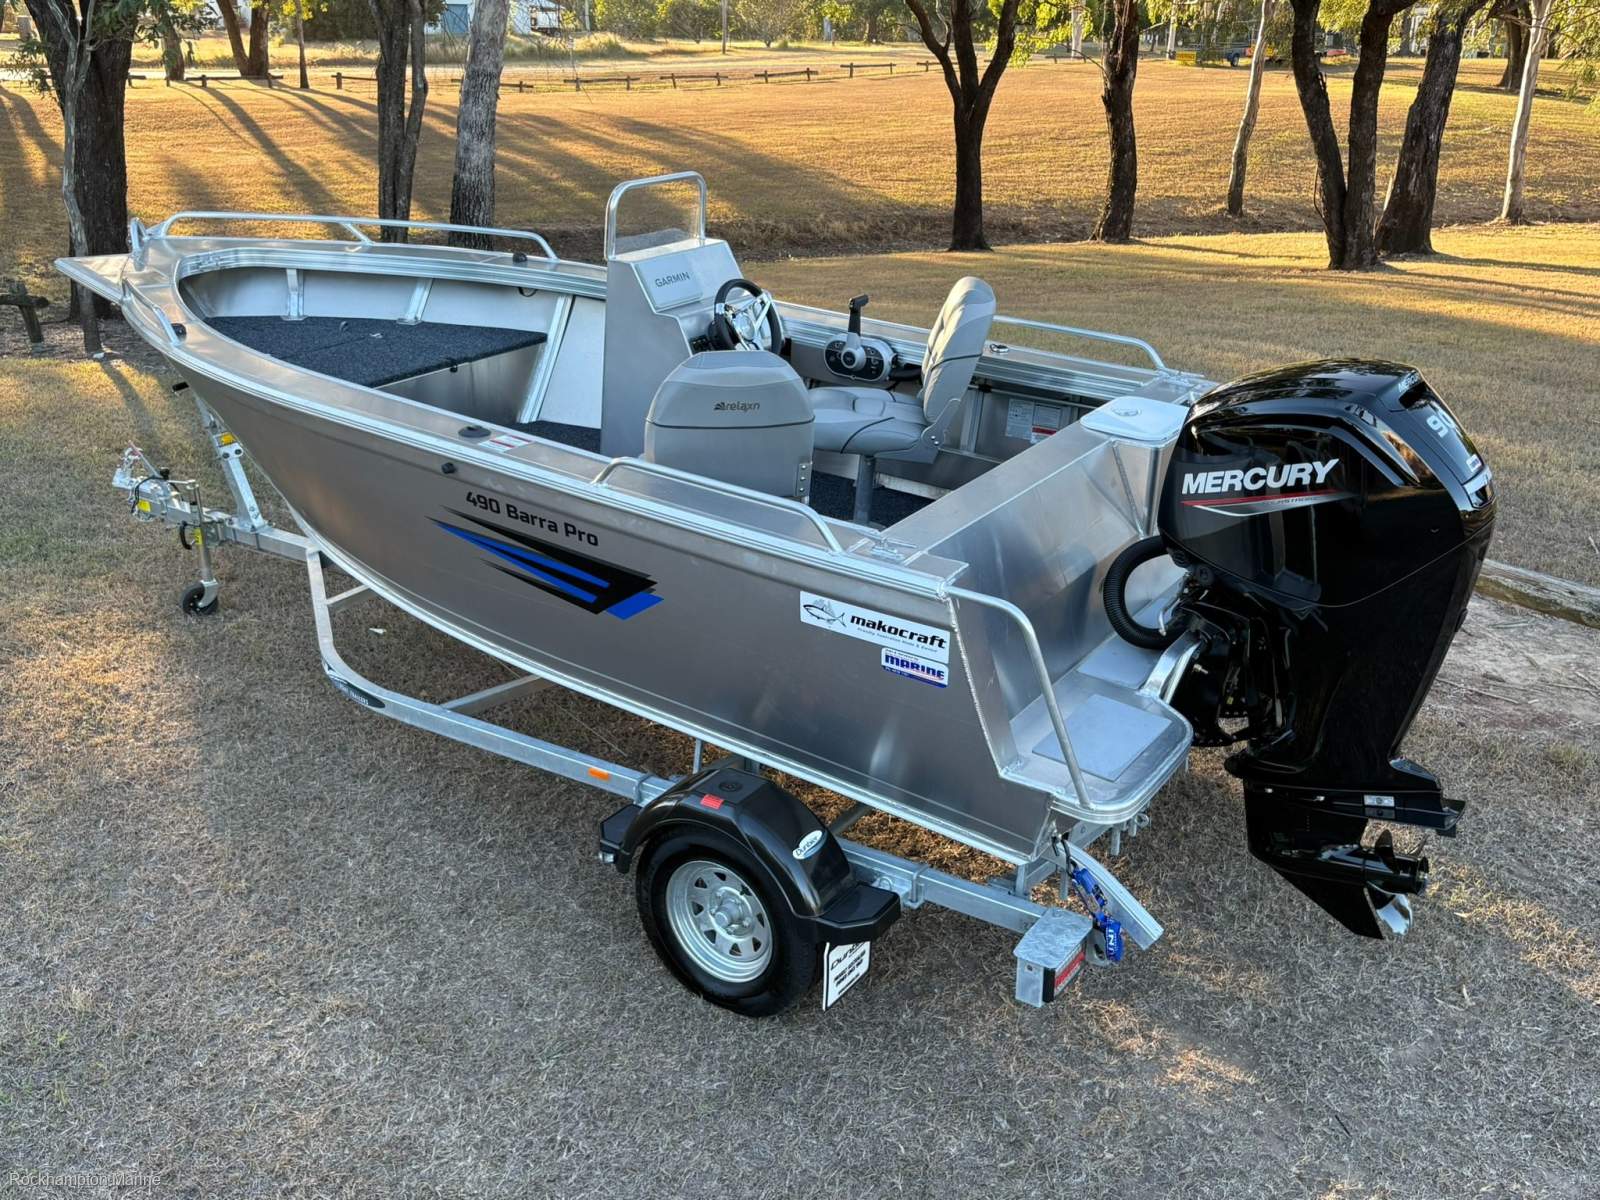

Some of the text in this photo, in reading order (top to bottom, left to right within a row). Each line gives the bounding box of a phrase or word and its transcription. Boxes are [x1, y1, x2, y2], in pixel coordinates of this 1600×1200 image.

[655, 272, 691, 288] GARMIN
[725, 401, 760, 413] relaxn
[1181, 458, 1340, 495] MERCURY
[466, 491, 599, 547] 490 Barra Pro
[850, 615, 947, 649] makocraft
